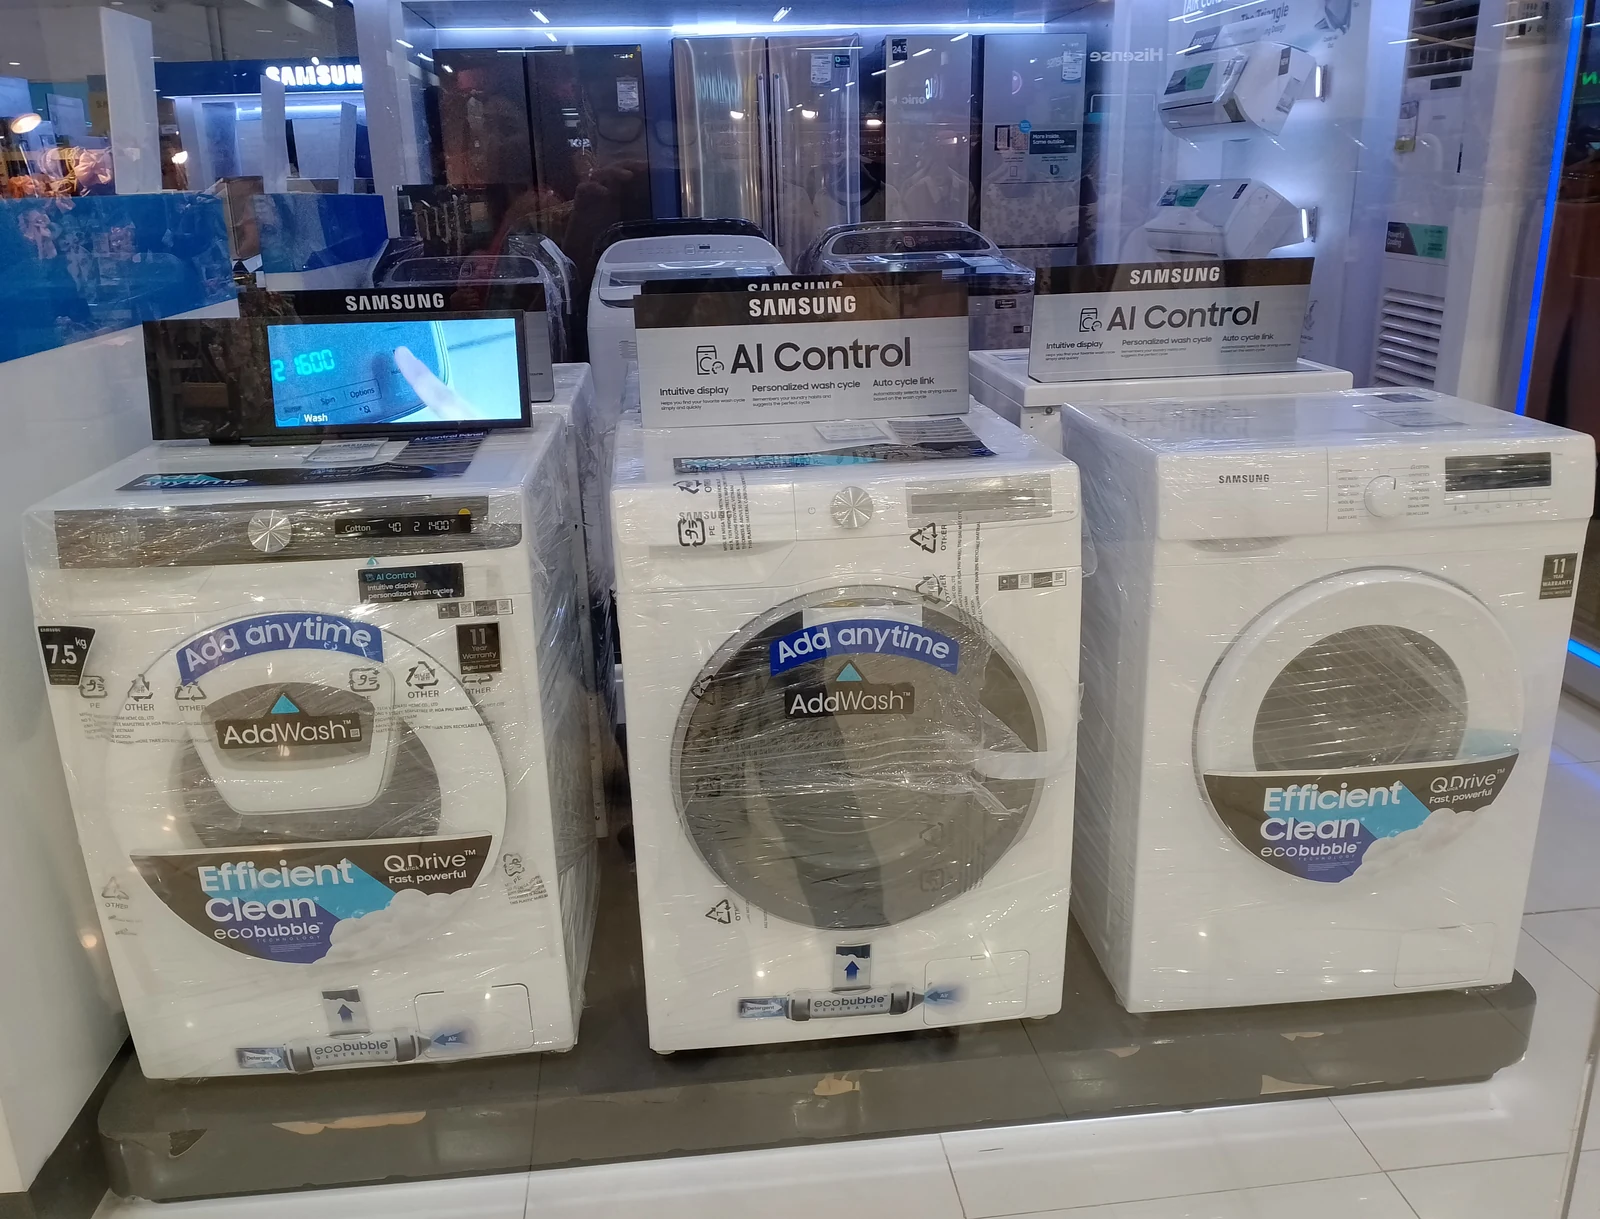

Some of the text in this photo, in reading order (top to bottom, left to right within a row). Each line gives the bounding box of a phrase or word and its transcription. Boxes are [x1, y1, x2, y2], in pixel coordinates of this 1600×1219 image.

[266, 64, 363, 86] SAMSUN
[1130, 266, 1221, 285] SAMSUNG
[346, 293, 445, 312] SAMSUNG
[749, 295, 856, 318] SAMSUNG
[1106, 300, 1260, 331] AI Control
[1122, 338, 1170, 346] Personalized
[1192, 336, 1213, 345] cycle
[1240, 334, 1260, 342] cycle
[1077, 340, 1104, 349] display
[730, 336, 912, 375] AI Control
[272, 348, 336, 383] 2 1600
[752, 380, 861, 392] Personalized wash cycle
[873, 376, 935, 388] Auto cycle link
[350, 388, 375, 399] Options
[660, 386, 729, 396] Intuitive display
[304, 414, 328, 422] Wash
[1218, 474, 1270, 484] SAMSUNG
[345, 520, 450, 533] Cotton 40 2 1400
[1553, 558, 1567, 574] 11
[376, 571, 417, 581] AI Control
[368, 590, 412, 600] personalized
[432, 588, 454, 596] cycles
[469, 628, 486, 645] 11
[185, 616, 372, 672] Add anytime
[778, 625, 950, 664] Add anytime
[46, 637, 87, 665] 7.5 kg
[462, 652, 497, 660] Warranty
[408, 690, 440, 699] OTHER
[125, 704, 155, 712] OTHER
[1263, 782, 1403, 812] Efficient
[1452, 788, 1493, 804] powerful
[198, 859, 355, 892] Efficient
[388, 870, 467, 884] Fast, powerful
[256, 935, 321, 943] TECHNOLOGY
[814, 1004, 884, 1012] GENERATOR
[246, 1054, 274, 1062] Detergent
[316, 1050, 389, 1060] GENERATOR
